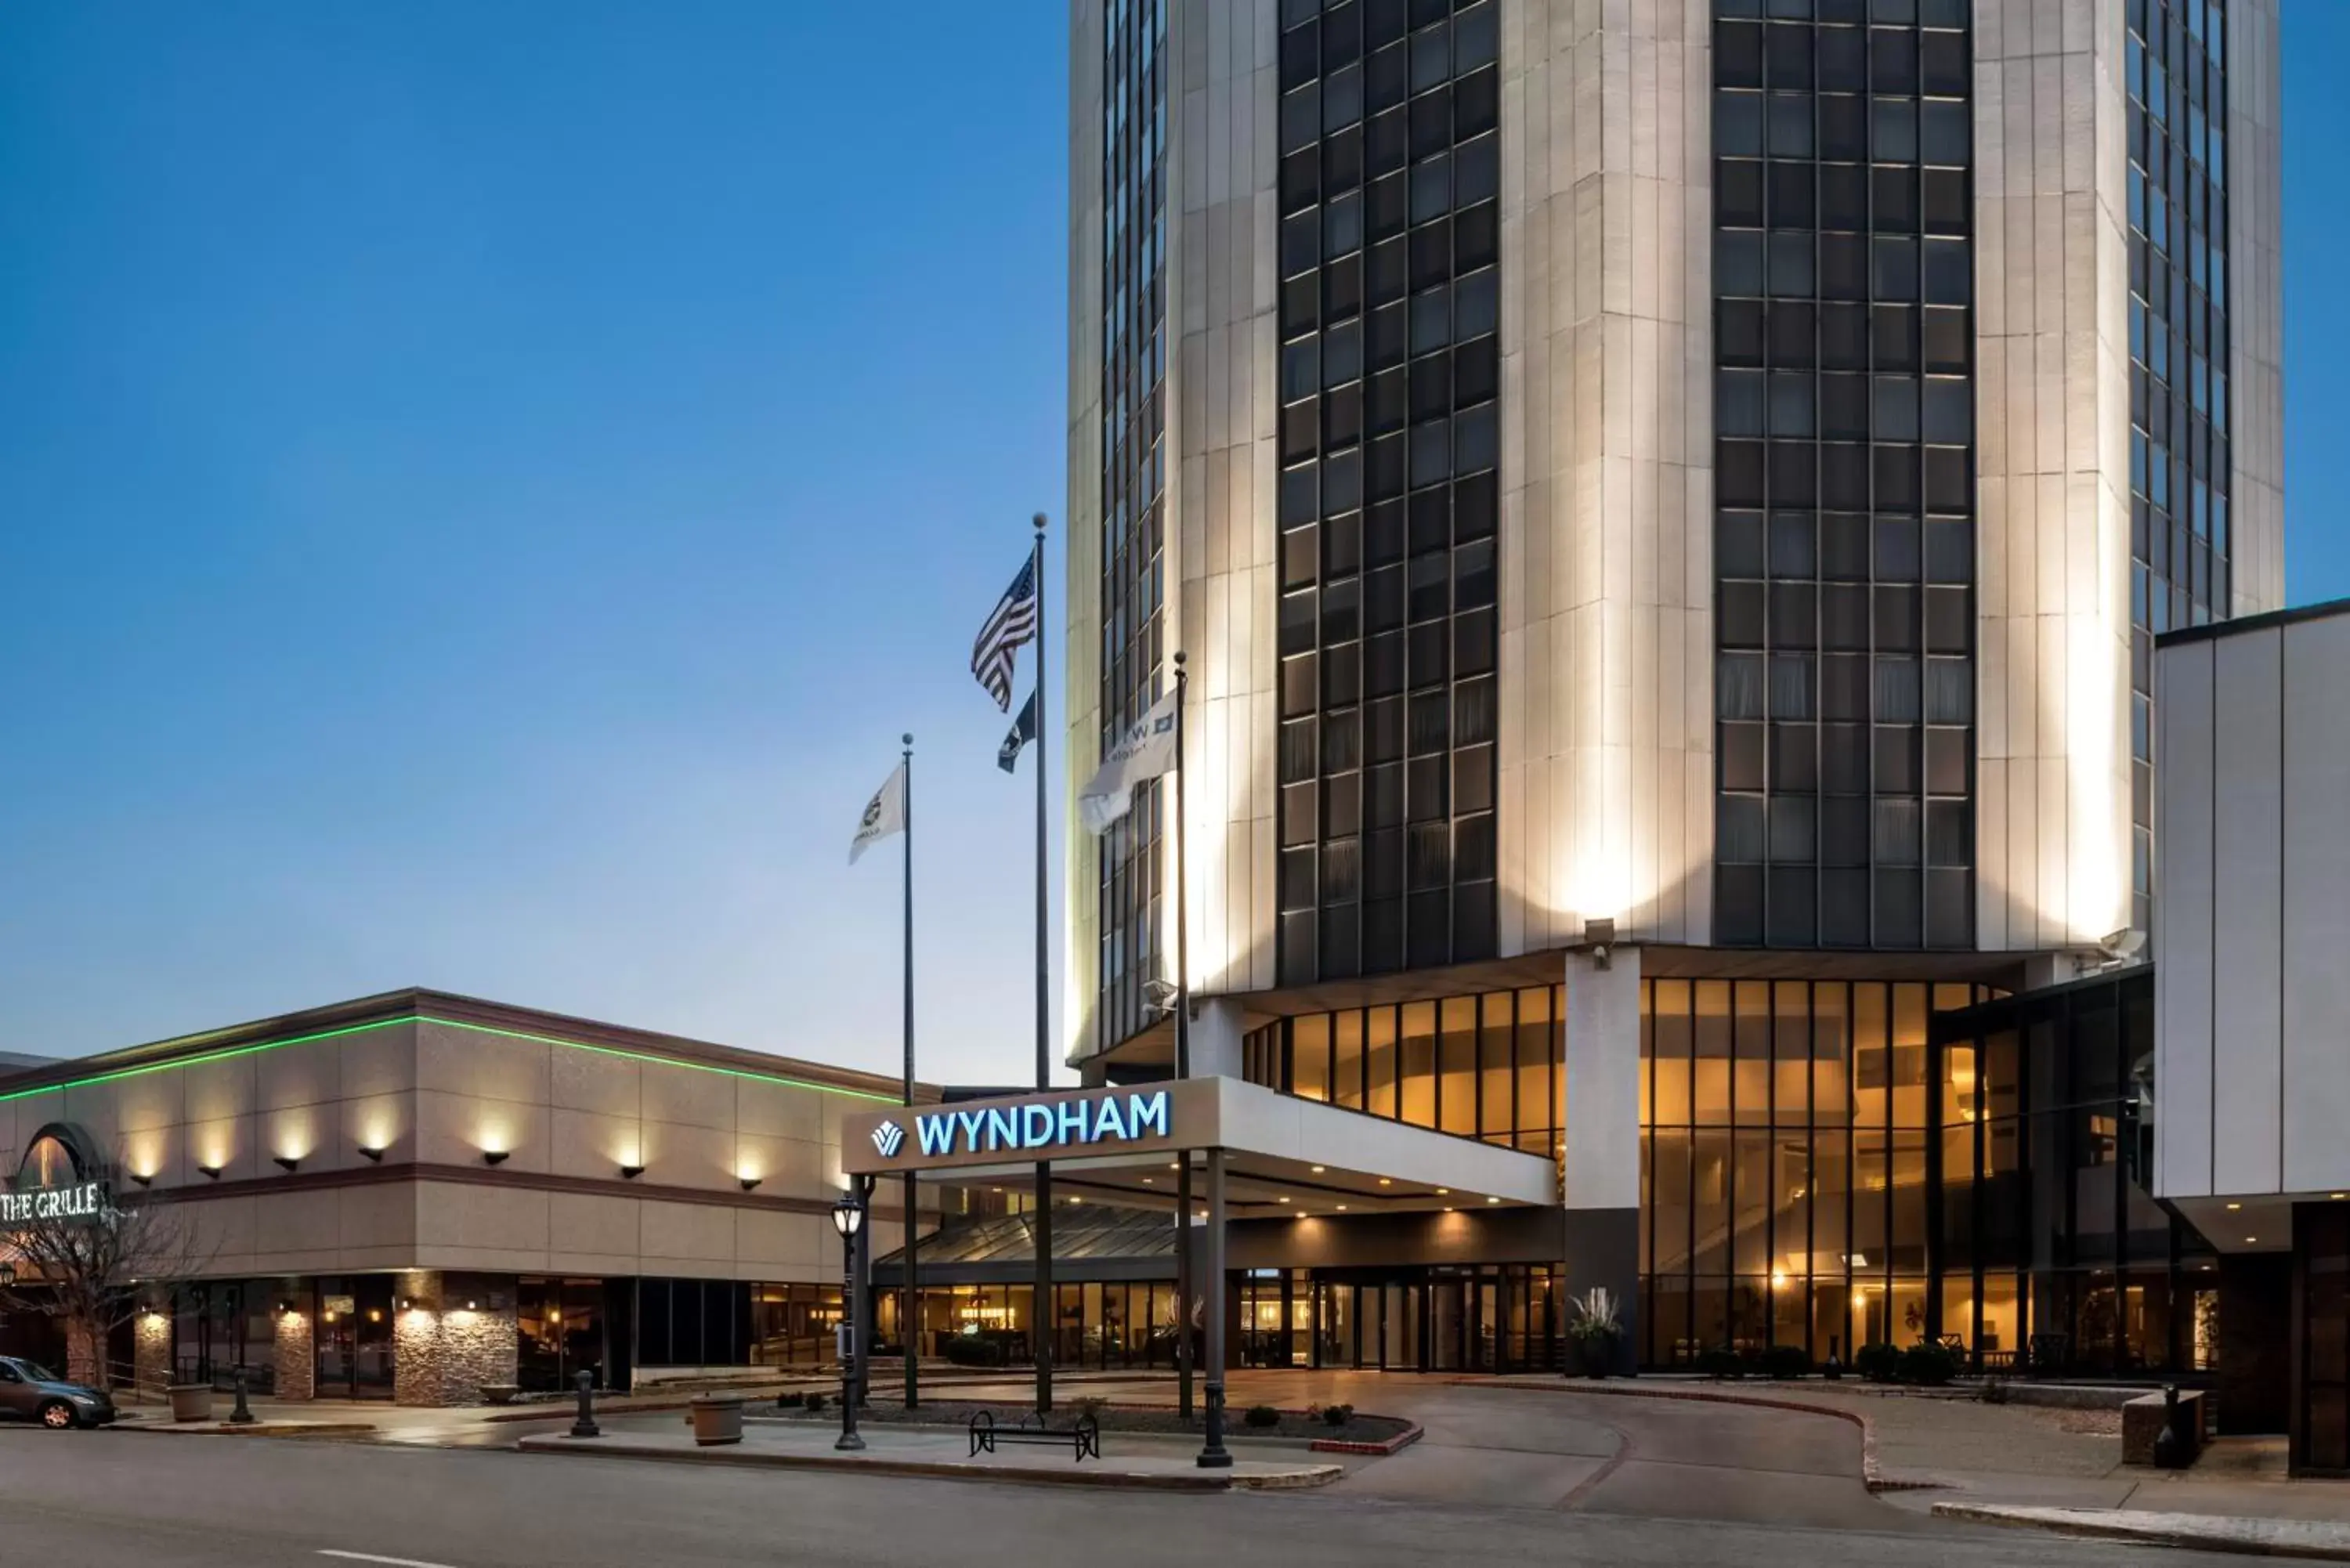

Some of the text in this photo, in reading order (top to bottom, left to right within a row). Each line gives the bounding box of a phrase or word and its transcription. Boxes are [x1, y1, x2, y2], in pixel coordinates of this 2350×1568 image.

[915, 1091, 1170, 1157] WYNDHAM
[0, 1182, 99, 1221] THE GRILLE
